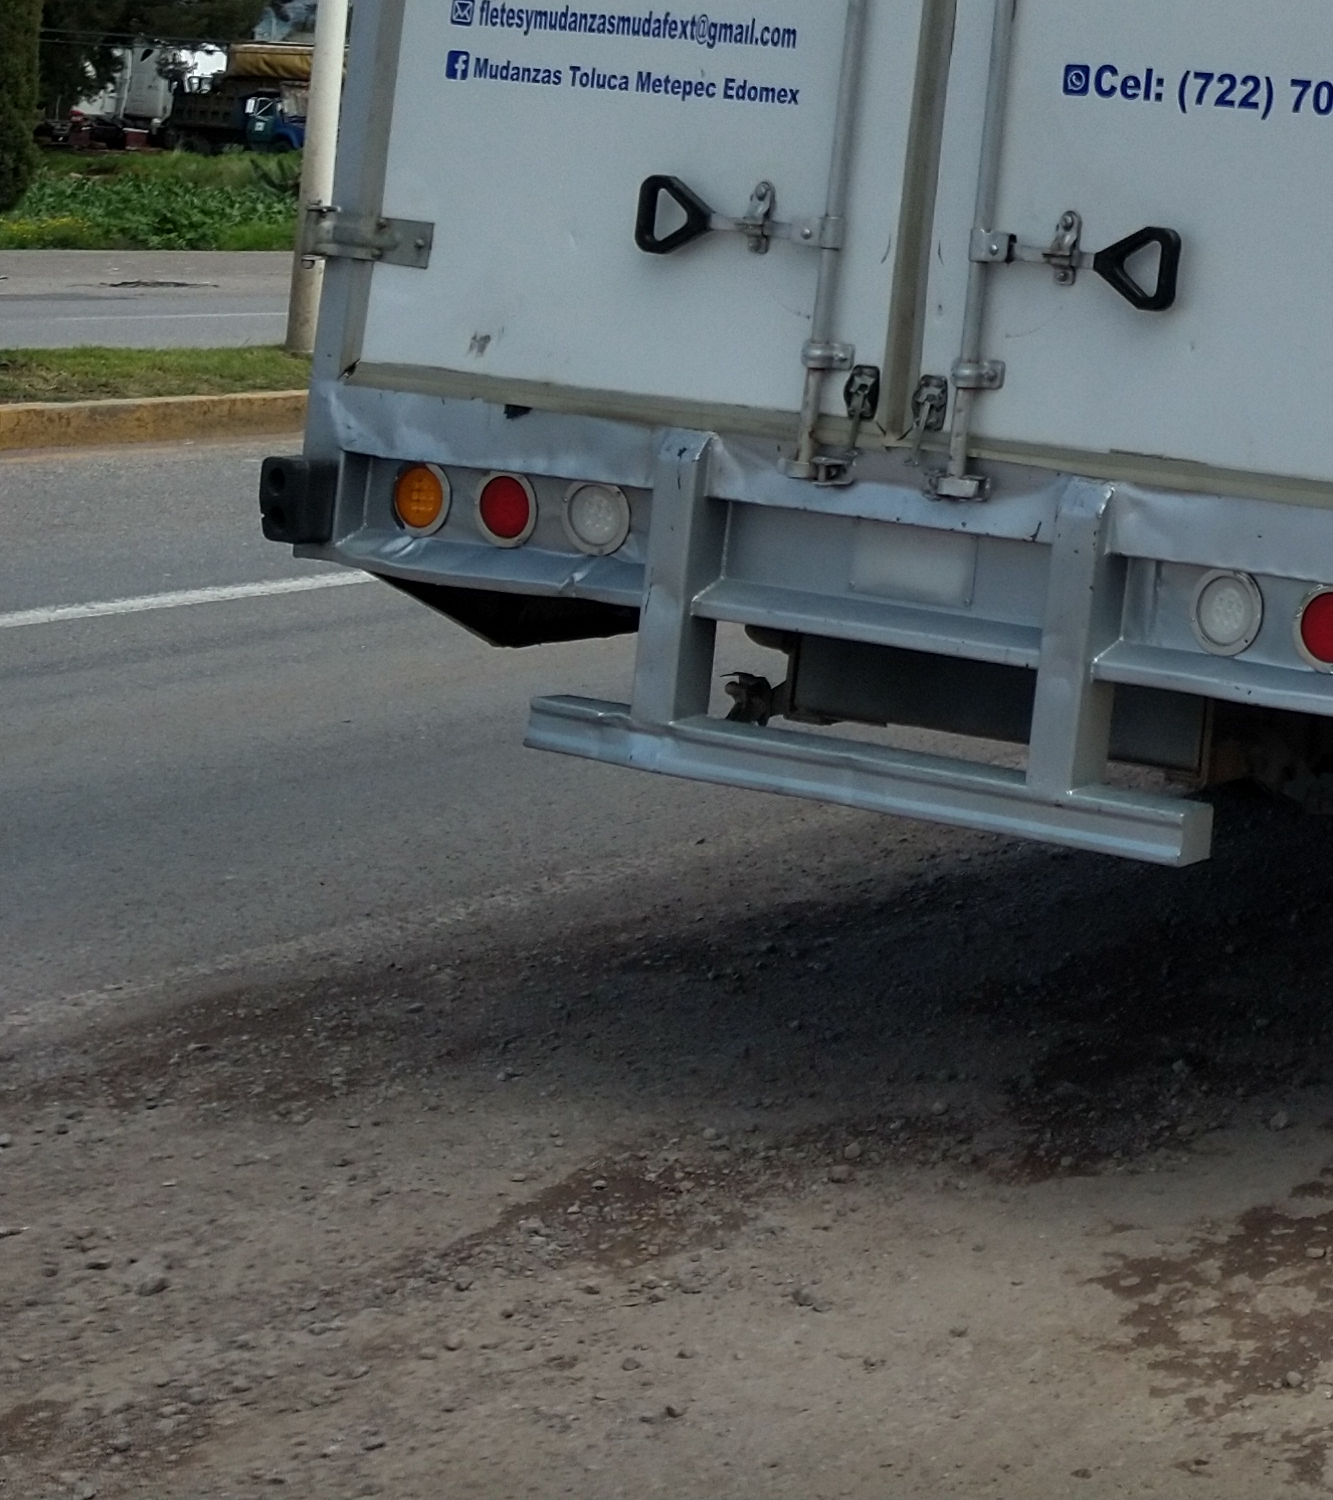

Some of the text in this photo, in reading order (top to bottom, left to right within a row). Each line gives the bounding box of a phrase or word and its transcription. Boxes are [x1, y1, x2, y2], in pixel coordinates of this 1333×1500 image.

[479, 0, 797, 49] fletesymudanzasmudafext@gmail.com
[473, 57, 800, 105] Mudanzas Toluca Metepec Edomex
[1094, 64, 1164, 102] Cel:
[1178, 70, 1274, 120] (722)
